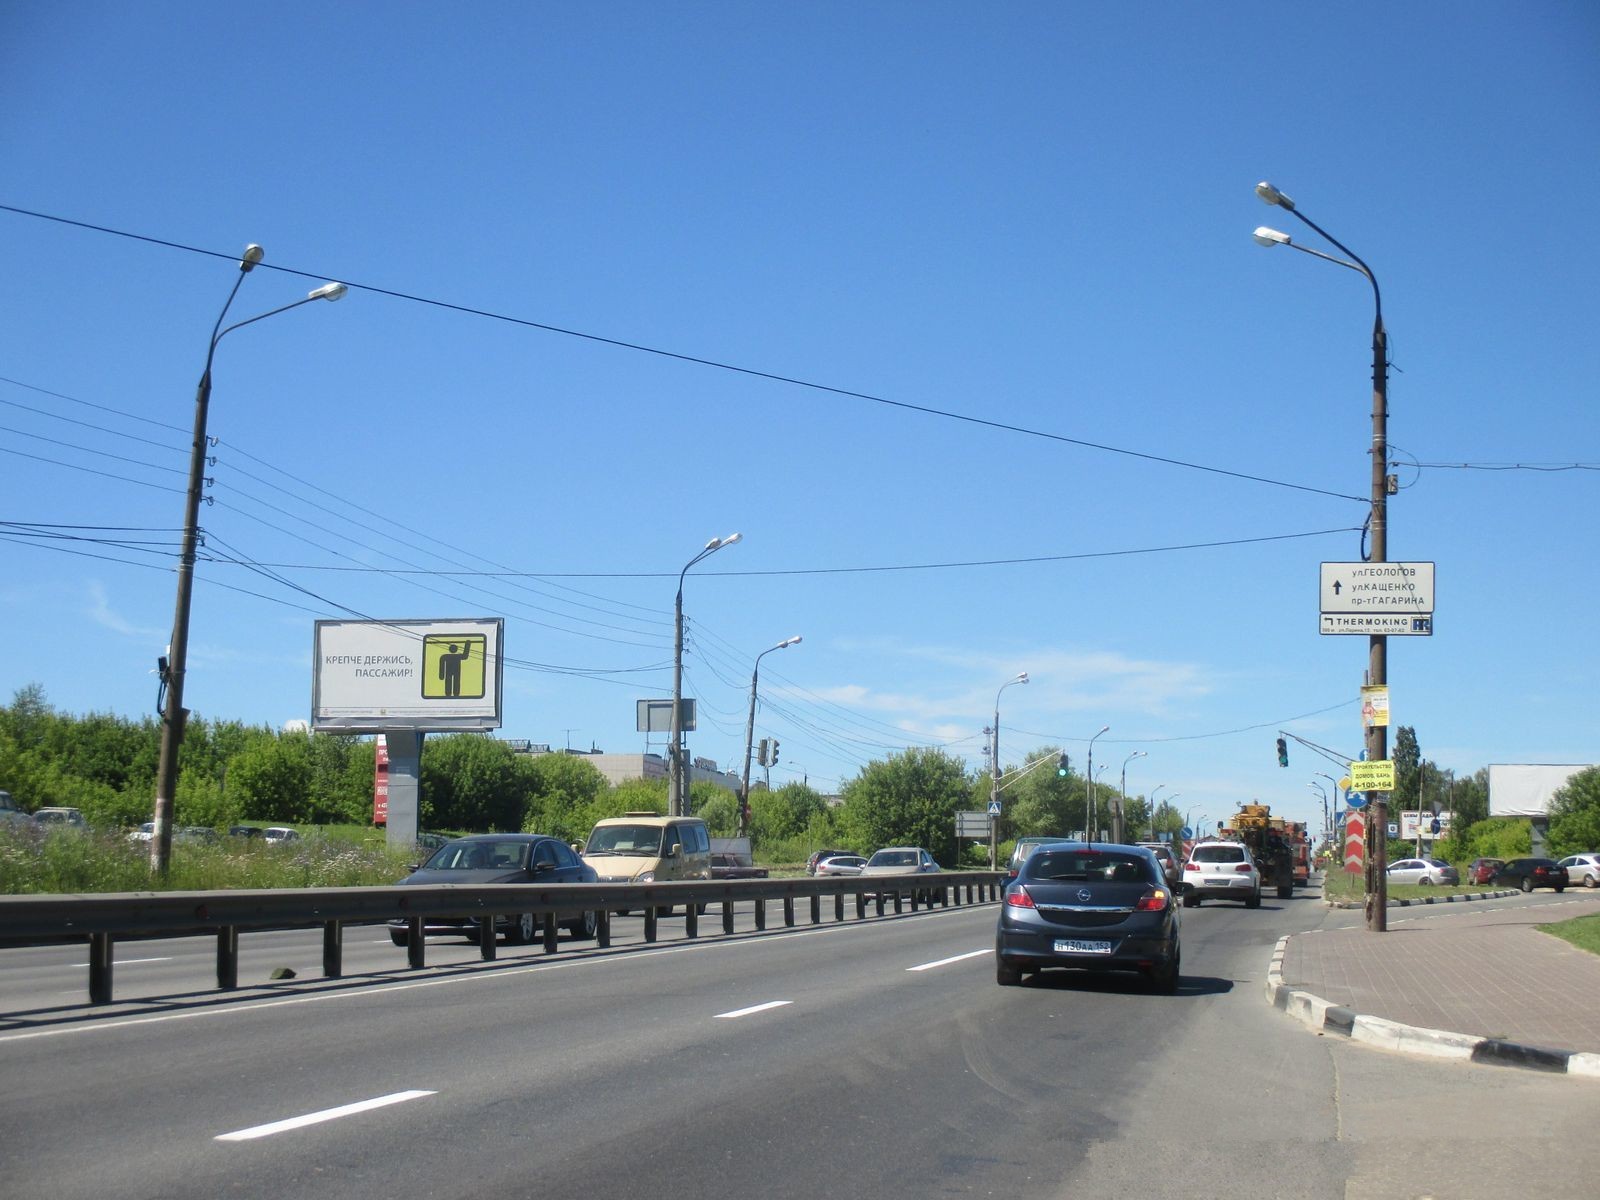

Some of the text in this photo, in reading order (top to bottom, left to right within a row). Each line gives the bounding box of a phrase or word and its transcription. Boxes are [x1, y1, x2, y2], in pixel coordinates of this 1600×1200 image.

[1336, 618, 1408, 626] THERMOKING
[326, 656, 413, 666] КРЕПЧЕ ДЕРЖИСЬ,
[355, 669, 413, 677] ПАССАЖИР!
